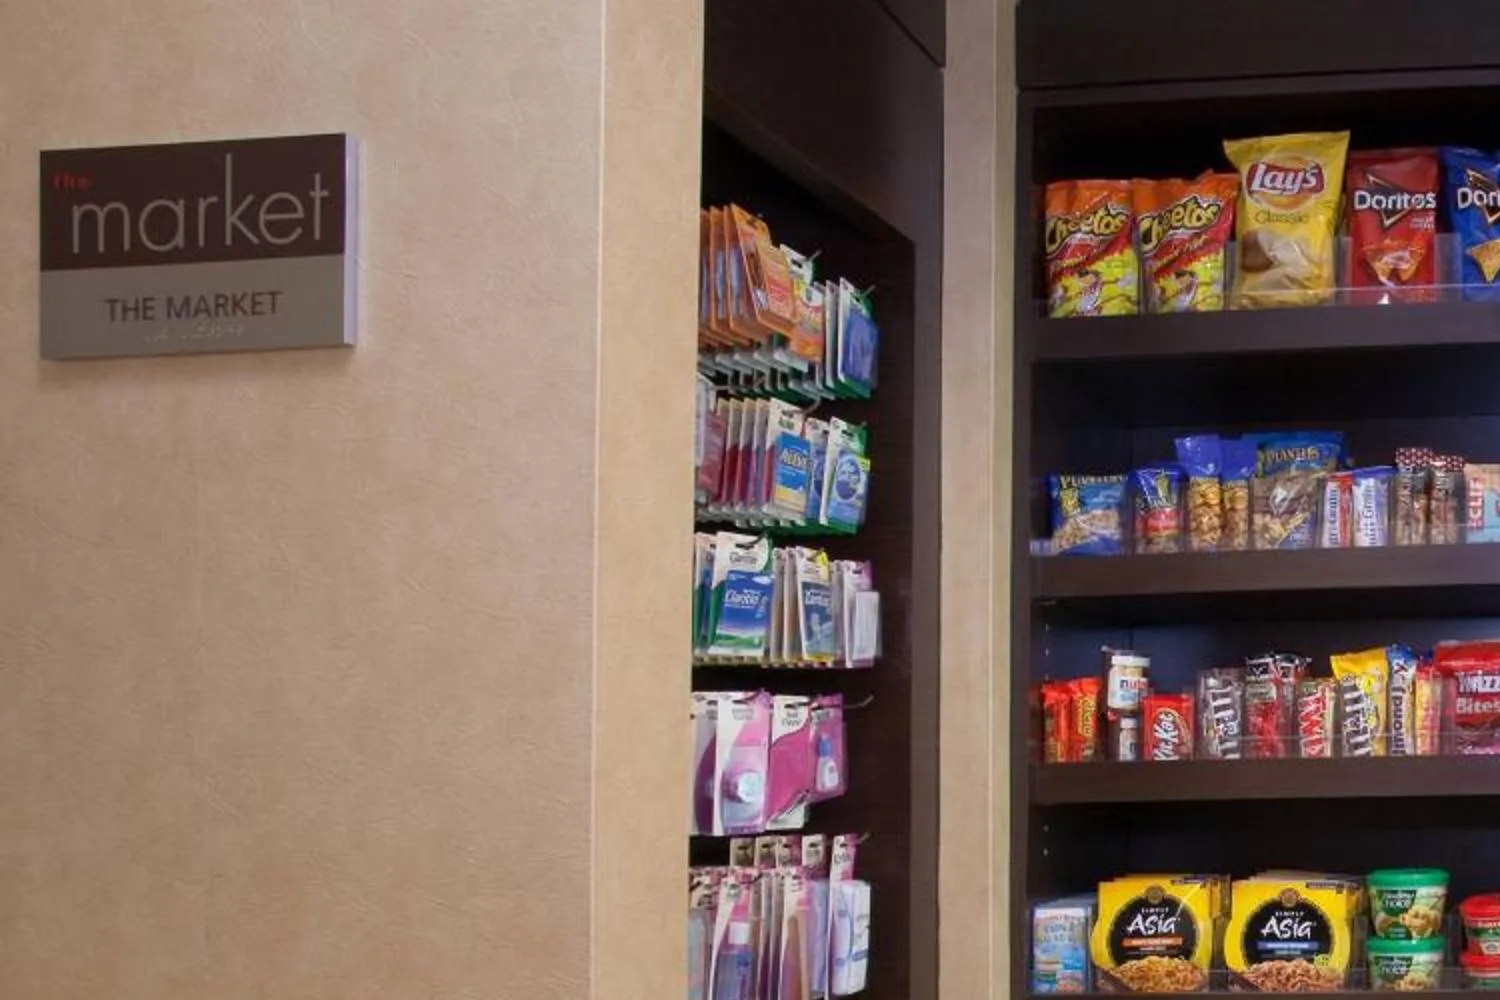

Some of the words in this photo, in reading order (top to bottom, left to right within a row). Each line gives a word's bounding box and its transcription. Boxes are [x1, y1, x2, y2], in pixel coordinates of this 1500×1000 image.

[72, 153, 330, 254] market
[1353, 190, 1437, 211] Doritos
[1046, 203, 1129, 255] Cheetos
[1138, 195, 1223, 254] Cheetos
[105, 298, 156, 323] THE
[166, 291, 284, 320] MARKET
[1126, 912, 1177, 936] Asia
[1260, 915, 1313, 939] Asia
